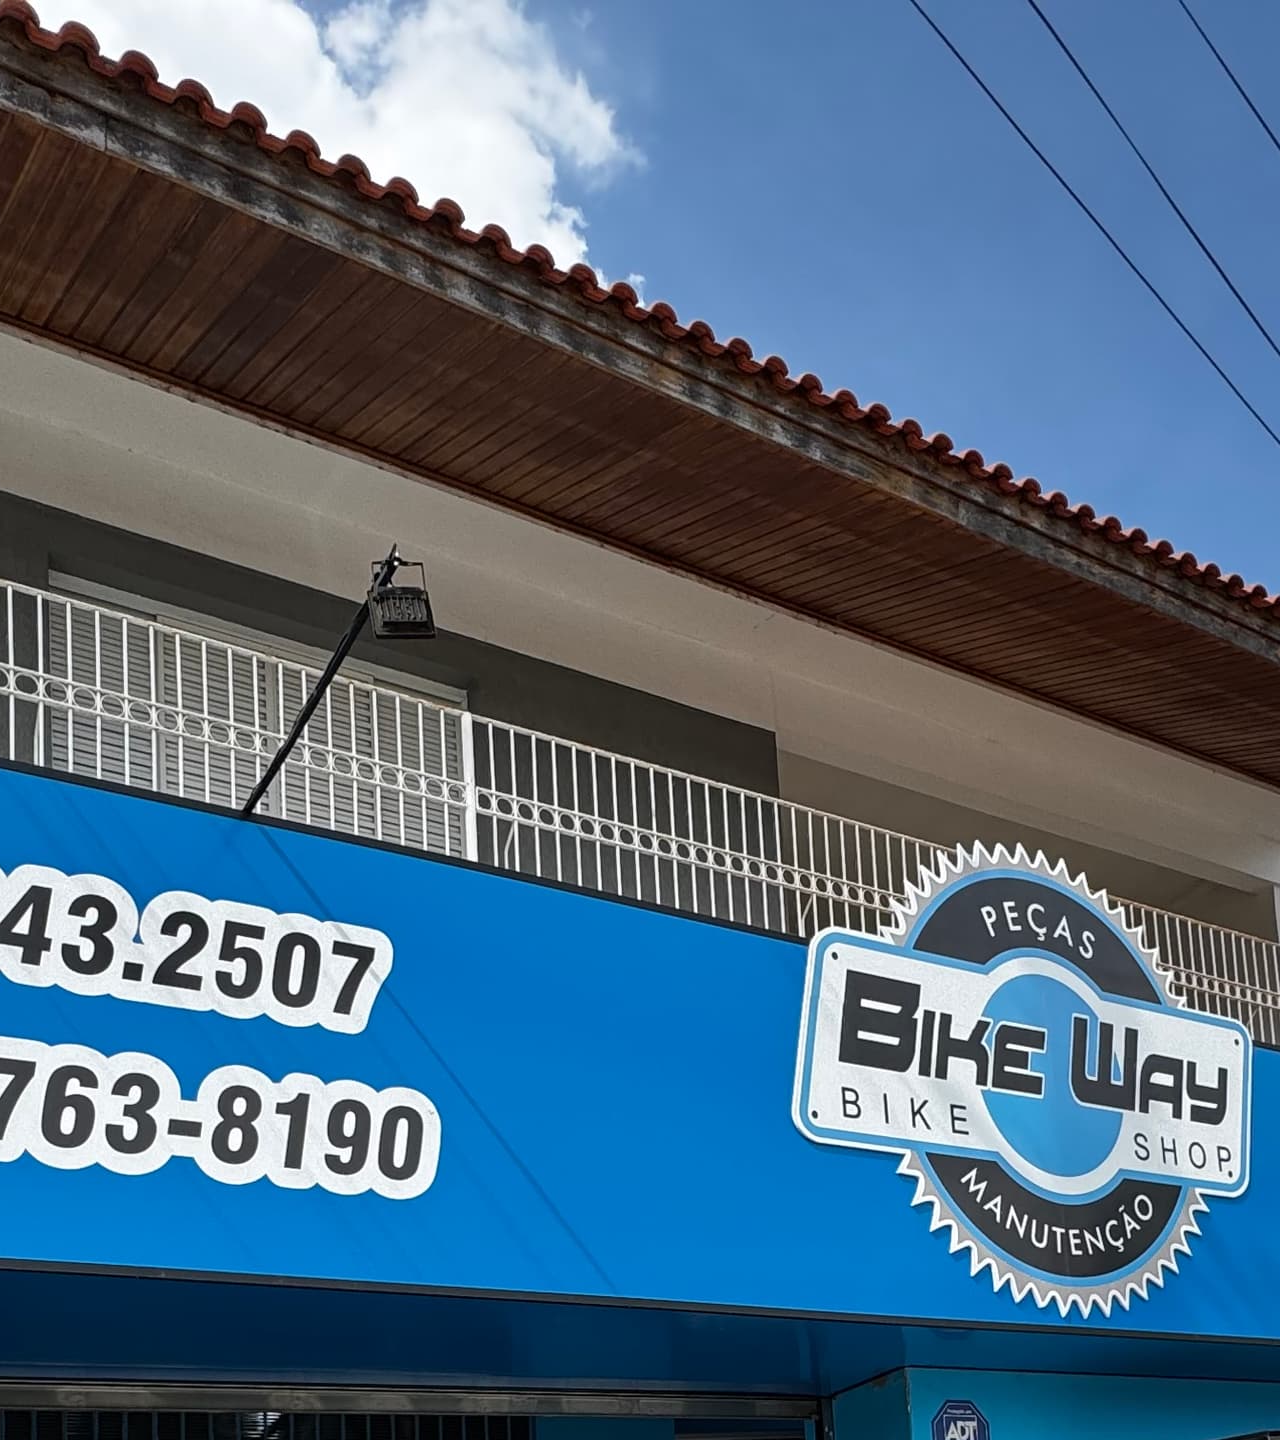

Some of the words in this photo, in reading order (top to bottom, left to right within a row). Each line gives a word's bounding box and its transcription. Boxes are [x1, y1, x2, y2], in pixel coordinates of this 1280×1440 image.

[979, 902, 1097, 961] PEÇAS
[841, 1086, 970, 1136] BIKE
[1133, 1132, 1233, 1172] SHOP
[960, 1166, 1154, 1257] MANUTENÇÃO
